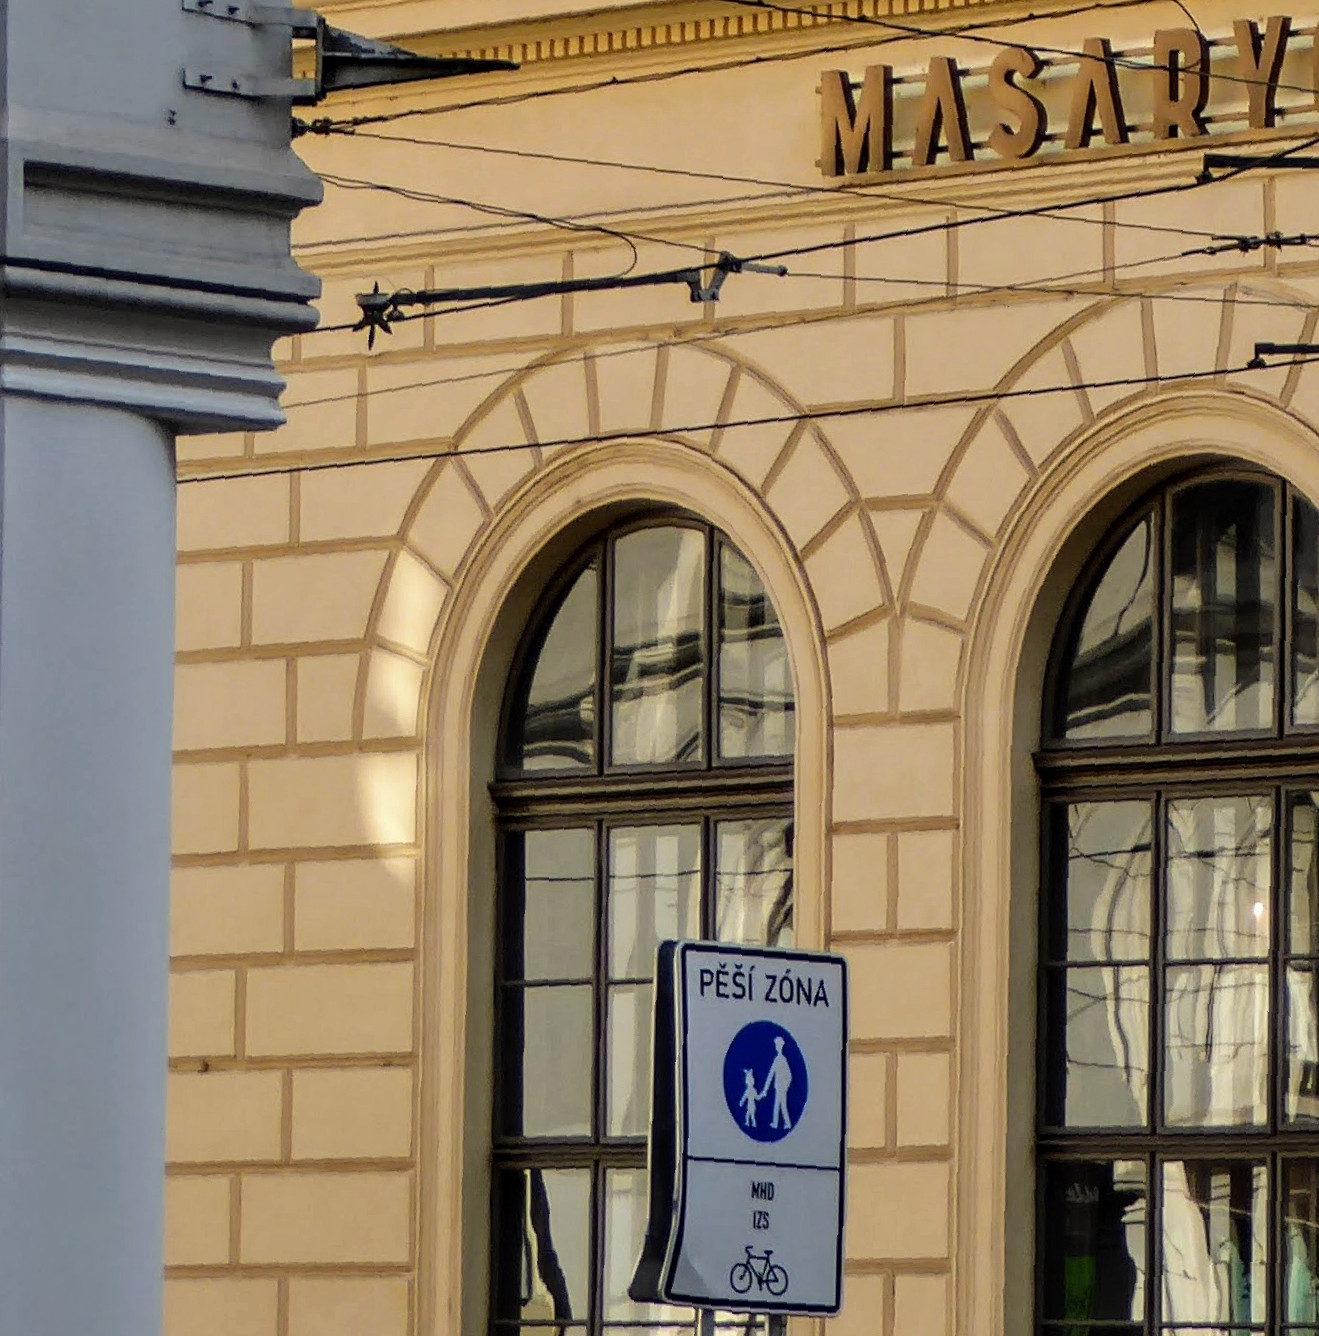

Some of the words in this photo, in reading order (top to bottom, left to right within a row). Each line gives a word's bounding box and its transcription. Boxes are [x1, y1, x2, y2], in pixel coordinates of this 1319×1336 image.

[700, 962, 755, 1001] PĚŠÍ
[765, 968, 829, 1007] ZÓNA
[751, 1181, 775, 1201] MHD
[753, 1211, 770, 1230] IZS
